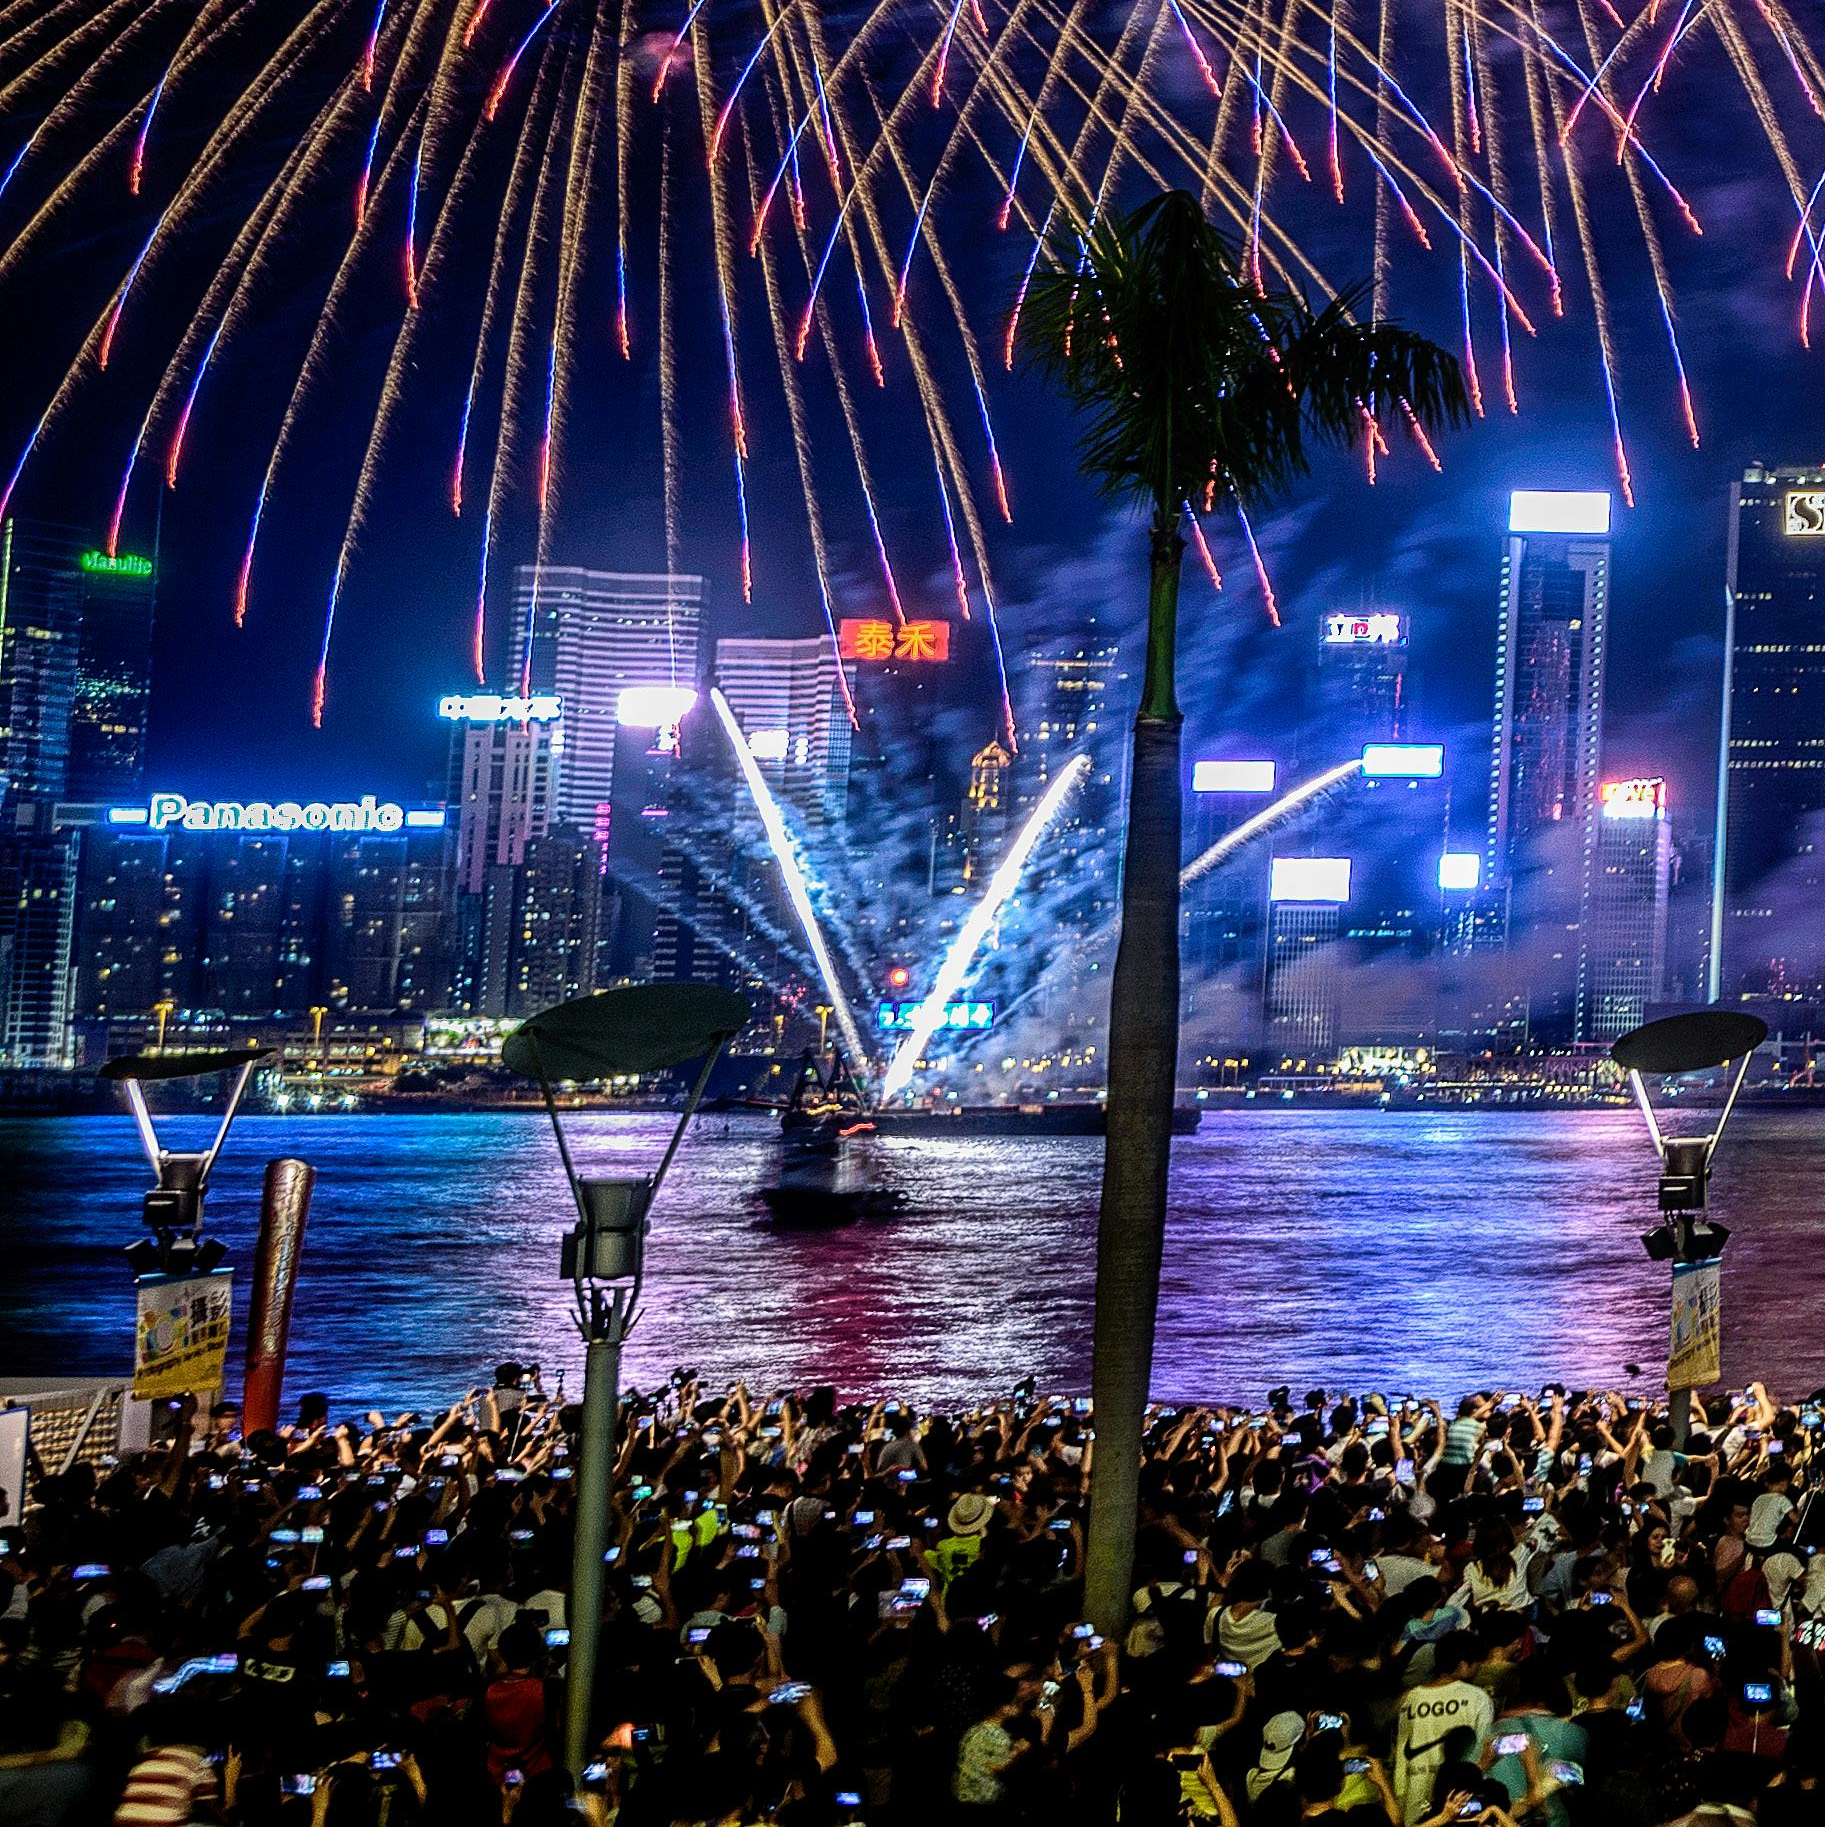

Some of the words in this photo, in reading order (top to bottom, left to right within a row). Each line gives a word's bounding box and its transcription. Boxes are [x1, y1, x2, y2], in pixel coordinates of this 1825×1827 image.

[83, 550, 153, 575] Manulife
[855, 619, 935, 660] 泰禾
[149, 792, 404, 832] Panasonic
